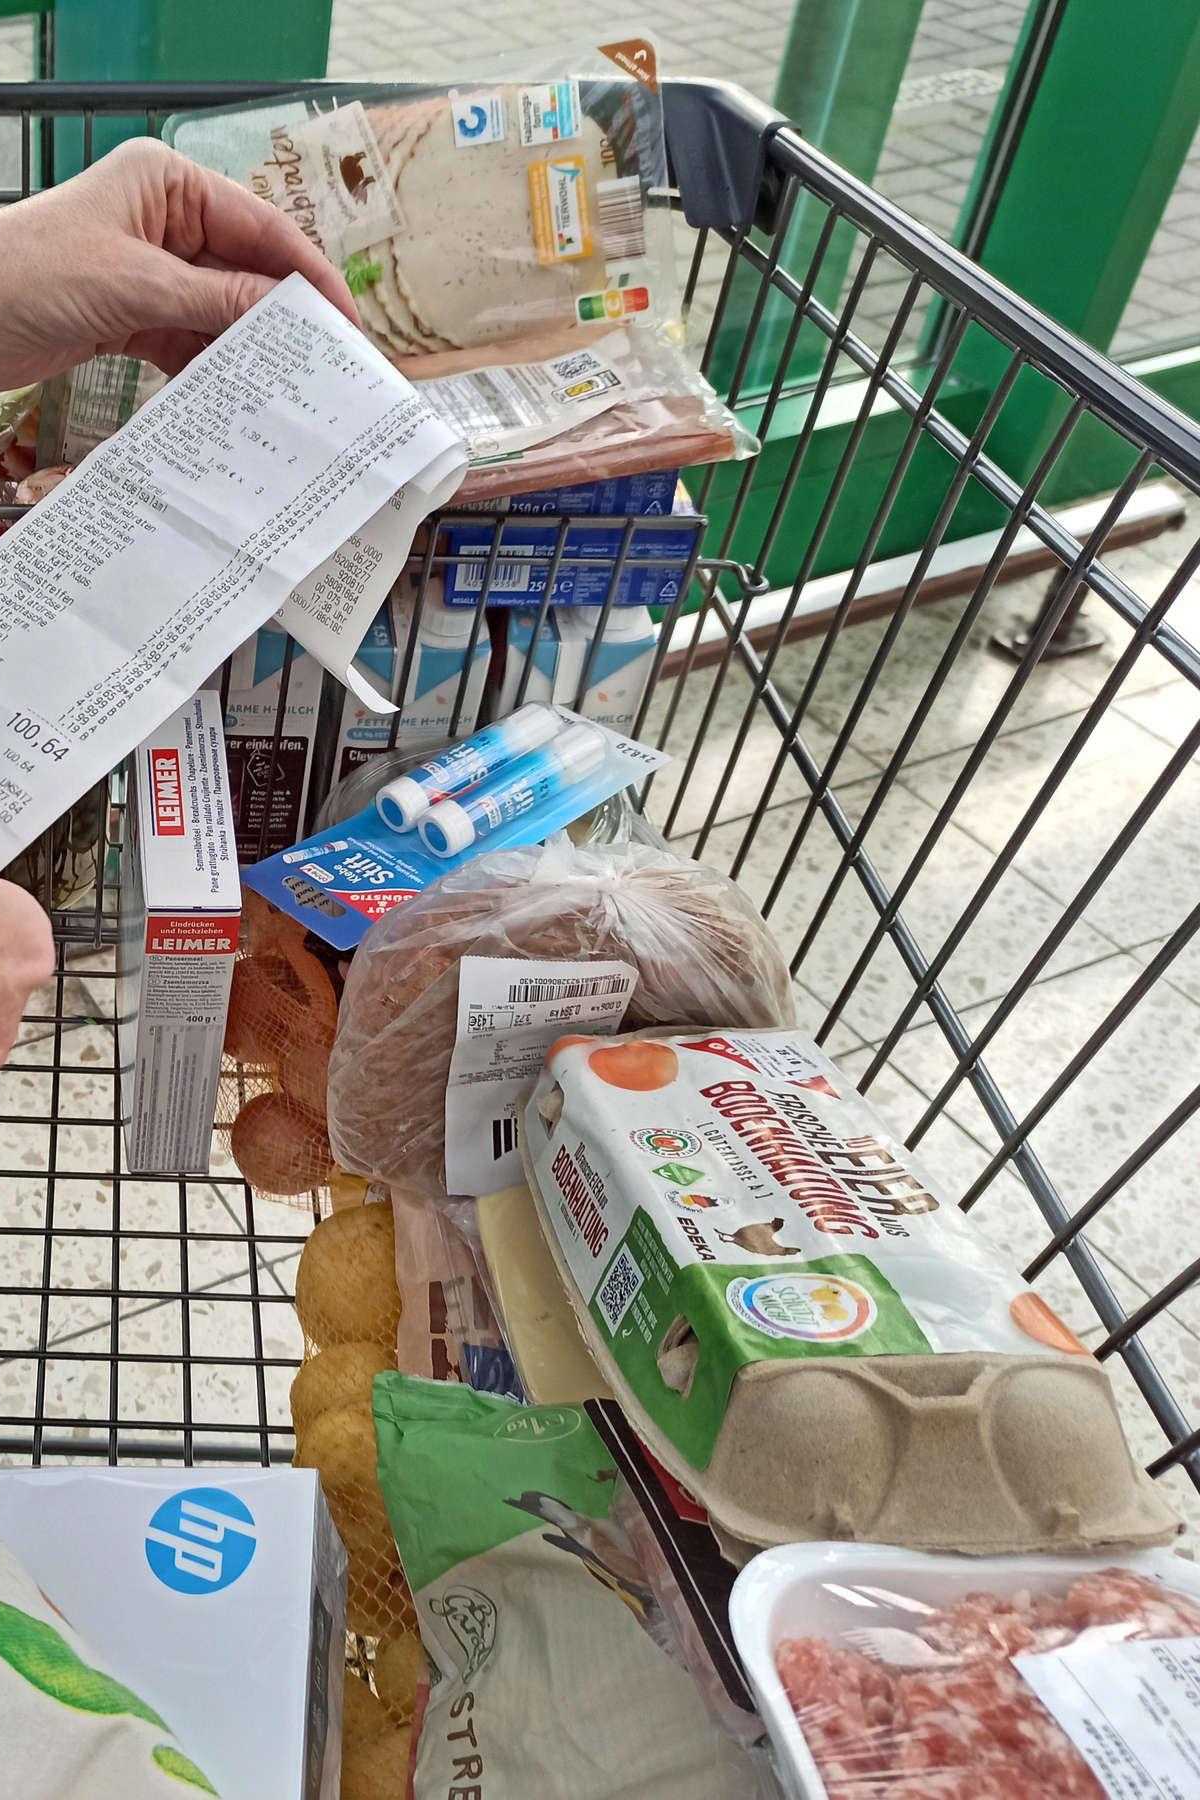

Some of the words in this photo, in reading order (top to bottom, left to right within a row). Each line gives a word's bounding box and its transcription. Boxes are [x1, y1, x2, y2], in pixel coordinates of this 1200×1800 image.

[557, 175, 571, 229] TIERWOHL
[198, 388, 238, 415] Farfalle
[165, 418, 205, 446] Zwiebeln
[182, 405, 229, 436] Kartoffeln
[239, 426, 261, 442] 1,39
[148, 432, 210, 474] Rauchschinken
[158, 425, 201, 456] Thunfisch
[140, 439, 201, 481] Schinkenwurst
[82, 470, 139, 508] Eisbergsalat
[91, 489, 157, 532] Schweinebraten
[15, 532, 49, 557] Tassimo
[56, 519, 87, 540] Harzer
[5, 540, 54, 574] THUERINGER
[43, 538, 97, 574] Zwiebelbrot
[352, 551, 377, 573] 06/27
[362, 543, 383, 562] 0000
[12, 560, 76, 606] Baconstreifen
[337, 569, 365, 594] 920810
[309, 592, 332, 613] 17:38
[3, 711, 70, 762] 100,64
[197, 732, 208, 773] Zsemlemorzsa
[0, 748, 36, 772] 100,64
[187, 752, 196, 781] Chapelure
[0, 777, 33, 807] UMSATZ
[157, 755, 180, 828] LEIMER
[189, 784, 199, 823] Breadcrumbs
[202, 803, 212, 825] rallado
[204, 825, 213, 837] Pan
[191, 826, 204, 872] Semmelbrösel
[207, 841, 219, 878] grattugiato
[208, 877, 219, 893] Pane
[333, 863, 361, 884] Klebe
[342, 851, 393, 885] Stift
[151, 938, 231, 950] LEIMER
[765, 1090, 843, 1151] FRISCHE
[699, 1078, 879, 1236] BODENHALTUNG
[703, 1128, 758, 1182] GÜTEKLASSE
[551, 1144, 608, 1258] BODENHALTUNG
[586, 1172, 605, 1197] EIER
[815, 1148, 941, 1221] EIER
[676, 1216, 715, 1260] EDEKA
[876, 1218, 909, 1239] AUS
[144, 1499, 256, 1583] hp
